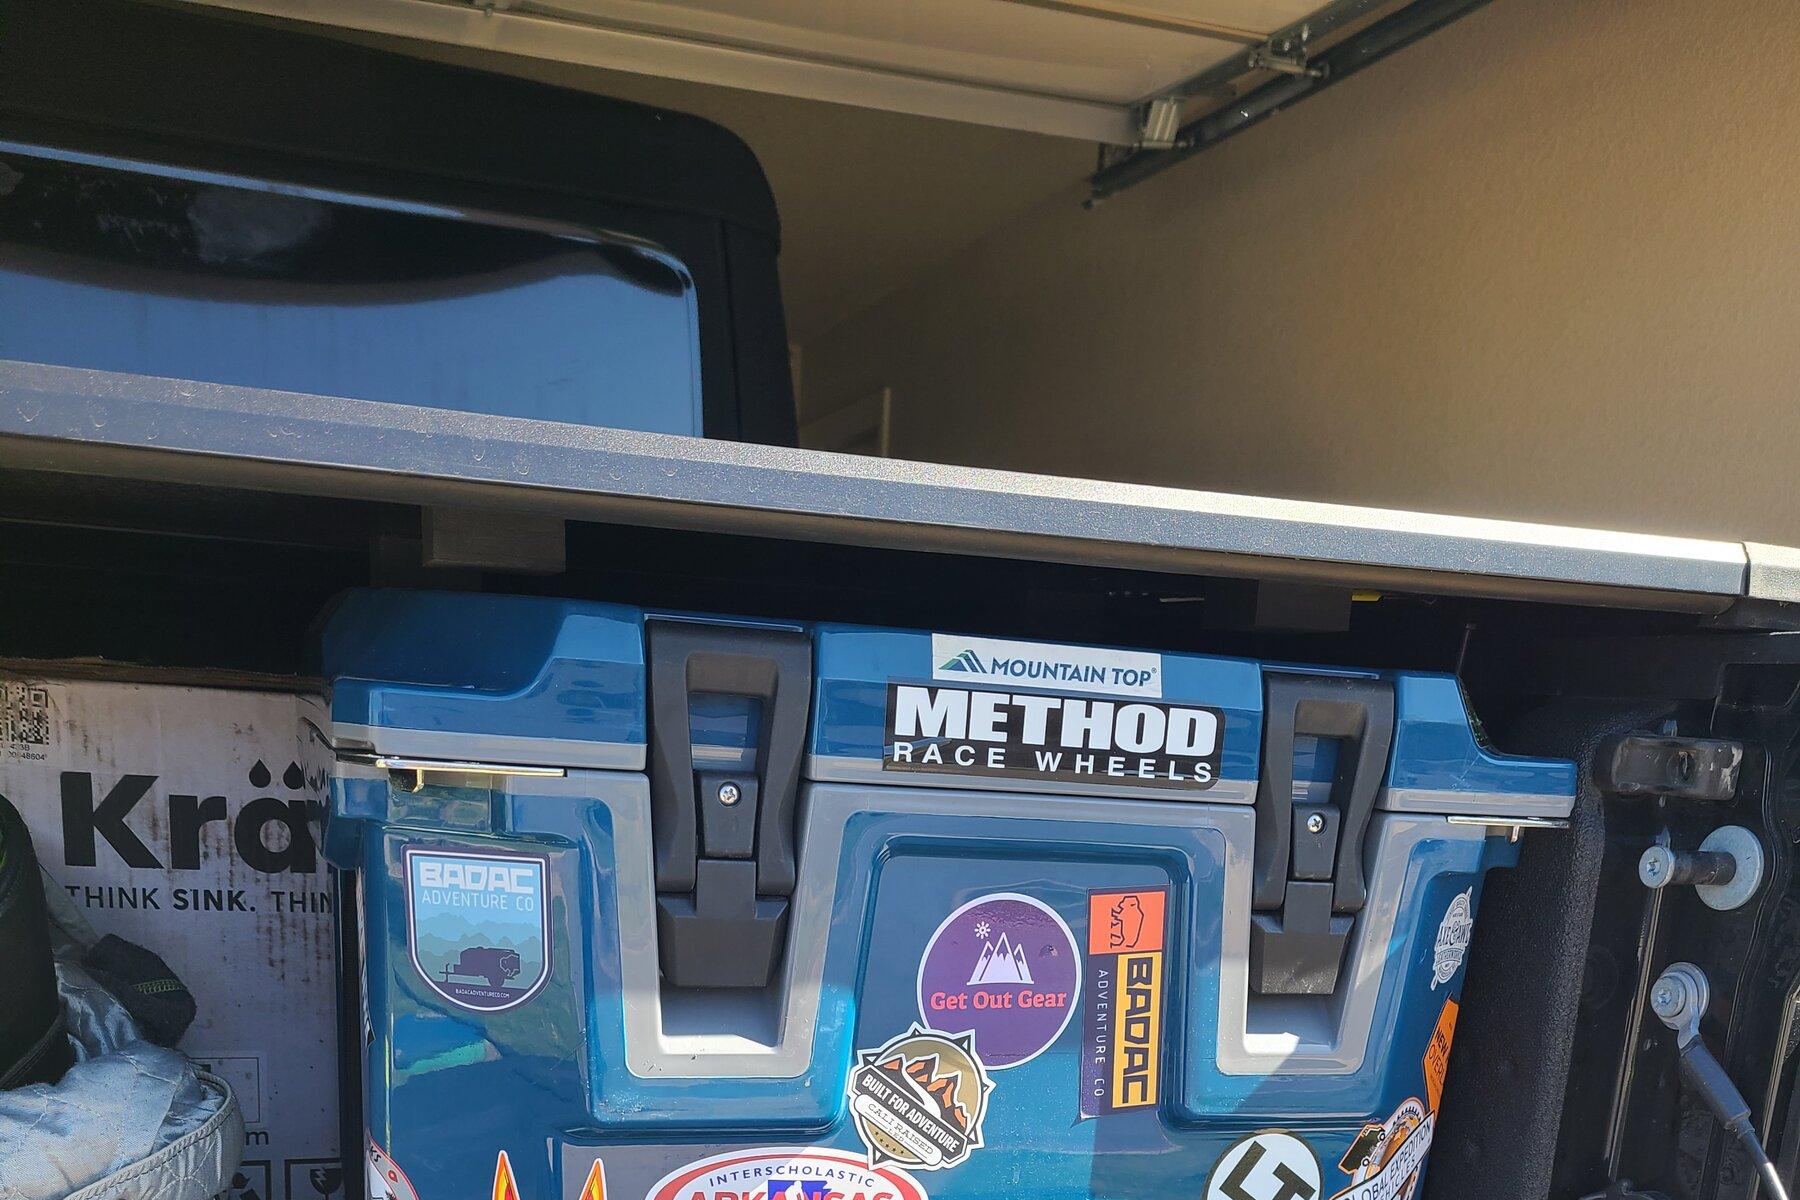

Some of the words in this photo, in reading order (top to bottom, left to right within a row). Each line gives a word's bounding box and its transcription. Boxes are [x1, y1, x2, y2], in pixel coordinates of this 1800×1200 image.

[991, 657, 1106, 684] MOUNTAIN
[894, 685, 1218, 757] METHOD
[893, 741, 1006, 769] RACE
[1035, 750, 1213, 783] WHEELS
[419, 861, 534, 894] BADAC
[64, 885, 161, 911] THINK
[172, 888, 256, 912] SINK.
[422, 890, 508, 910] ADVENTURE
[516, 896, 534, 912] CO
[930, 991, 968, 1010] Get
[972, 990, 1012, 1010] Out
[1017, 989, 1067, 1009] Gear
[1094, 969, 1109, 1065] ADVENTURE
[1122, 956, 1154, 1104] BADAC
[1093, 1079, 1105, 1098] CO
[861, 1073, 892, 1102] BUILT
[888, 1093, 911, 1116] FOR
[906, 1109, 960, 1153] ADVENTURE
[868, 1103, 895, 1125] CALI
[894, 1122, 934, 1155] RAISED
[888, 1129, 904, 1142] LED
[1390, 1122, 1432, 1179] EXPEDITION
[709, 1165, 876, 1188] INTERSCHOLASTIC
